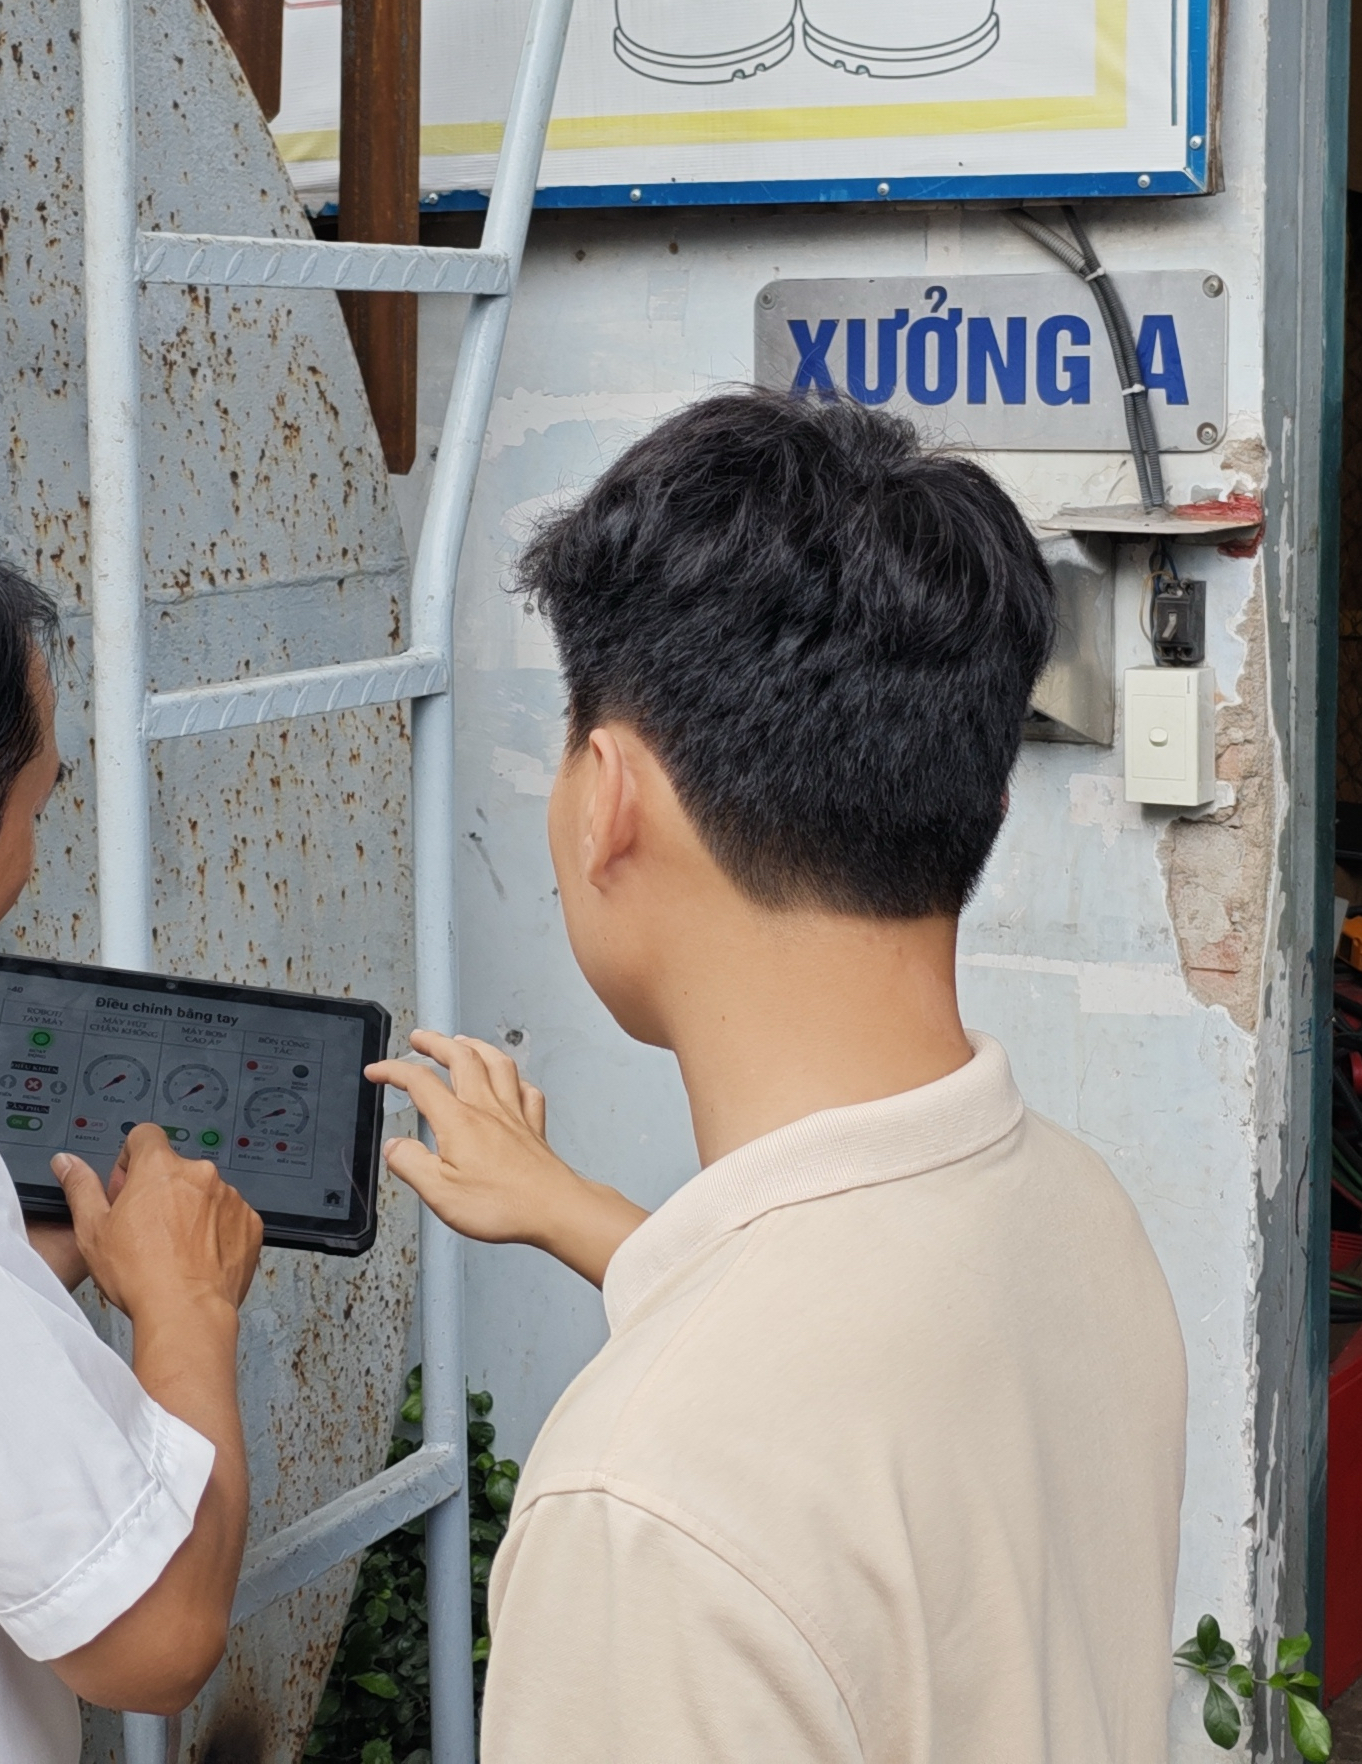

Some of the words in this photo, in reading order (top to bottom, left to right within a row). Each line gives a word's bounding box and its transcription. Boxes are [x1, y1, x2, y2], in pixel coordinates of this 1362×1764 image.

[786, 285, 1092, 406] XƯỞNG
[1136, 314, 1189, 406] A
[95, 996, 129, 1011] Điều
[132, 1001, 173, 1017] chỉnh
[176, 1006, 213, 1024] bằng
[216, 1012, 239, 1027] tay
[184, 1035, 207, 1044] CAO
